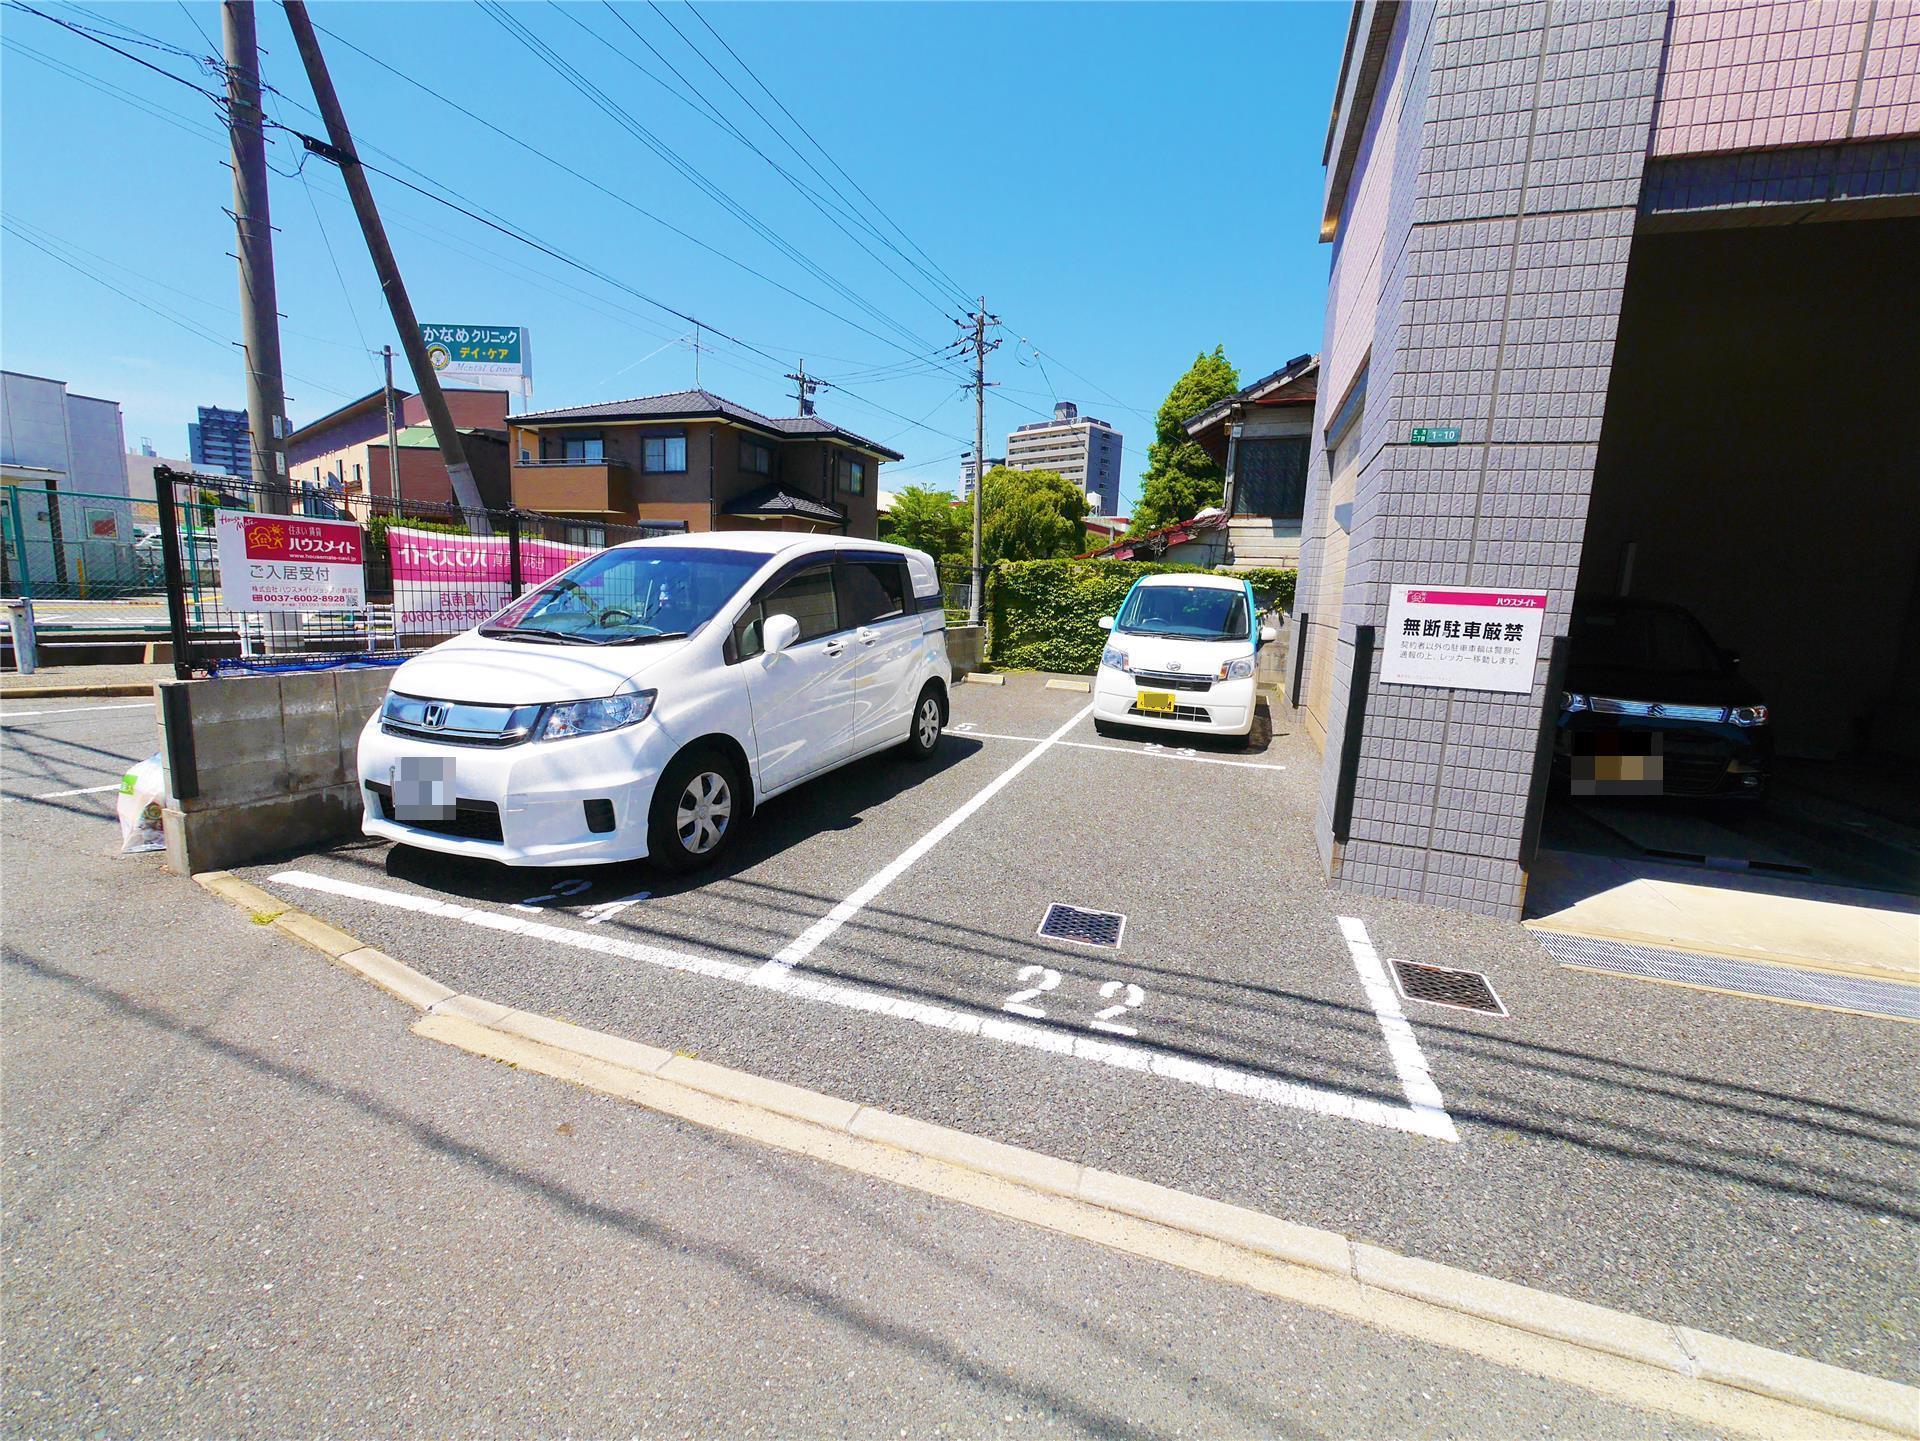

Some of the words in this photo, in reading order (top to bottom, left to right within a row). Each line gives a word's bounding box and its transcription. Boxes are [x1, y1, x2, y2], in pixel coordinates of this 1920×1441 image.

[423, 326, 517, 344] かなめクリニック
[1432, 430, 1455, 440] 1-10
[288, 537, 356, 554] ハウスメイト
[249, 564, 330, 582] ご入居受付
[263, 594, 345, 603] 0037-6002-8928
[1495, 597, 1537, 607] ハウスメイト
[1402, 617, 1524, 642] 無断駐車厳禁
[1001, 965, 1145, 1036] 22
